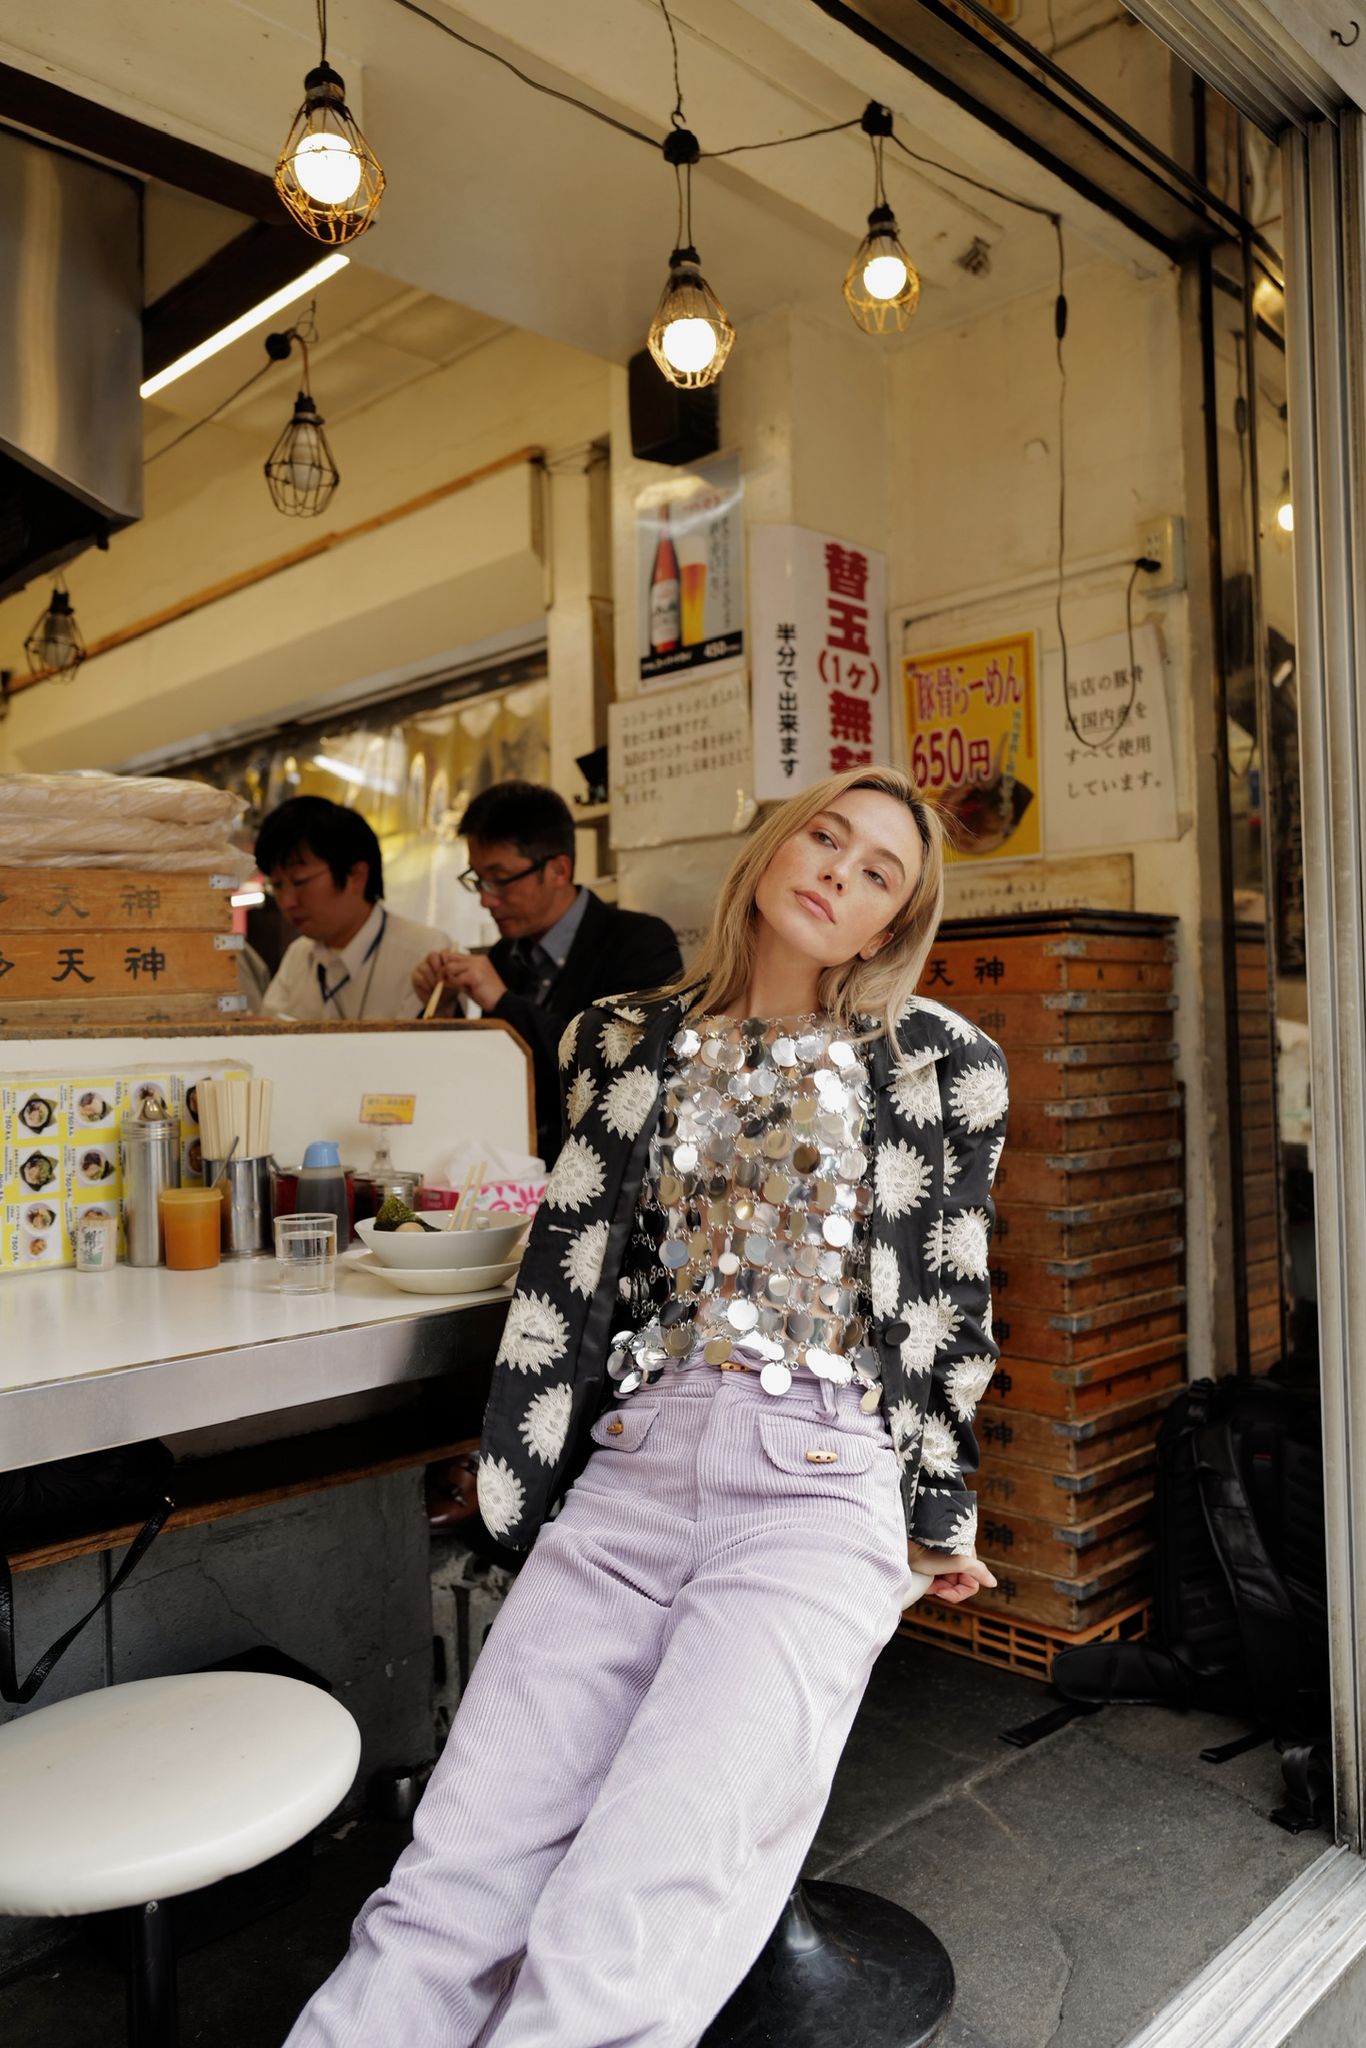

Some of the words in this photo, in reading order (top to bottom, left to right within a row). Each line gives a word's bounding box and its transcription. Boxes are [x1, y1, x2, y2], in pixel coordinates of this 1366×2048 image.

[776, 624, 800, 779] 半分で出来ます
[911, 728, 993, 788] 650円
[1065, 734, 1151, 766] すべて使用
[926, 954, 1006, 987] 天神
